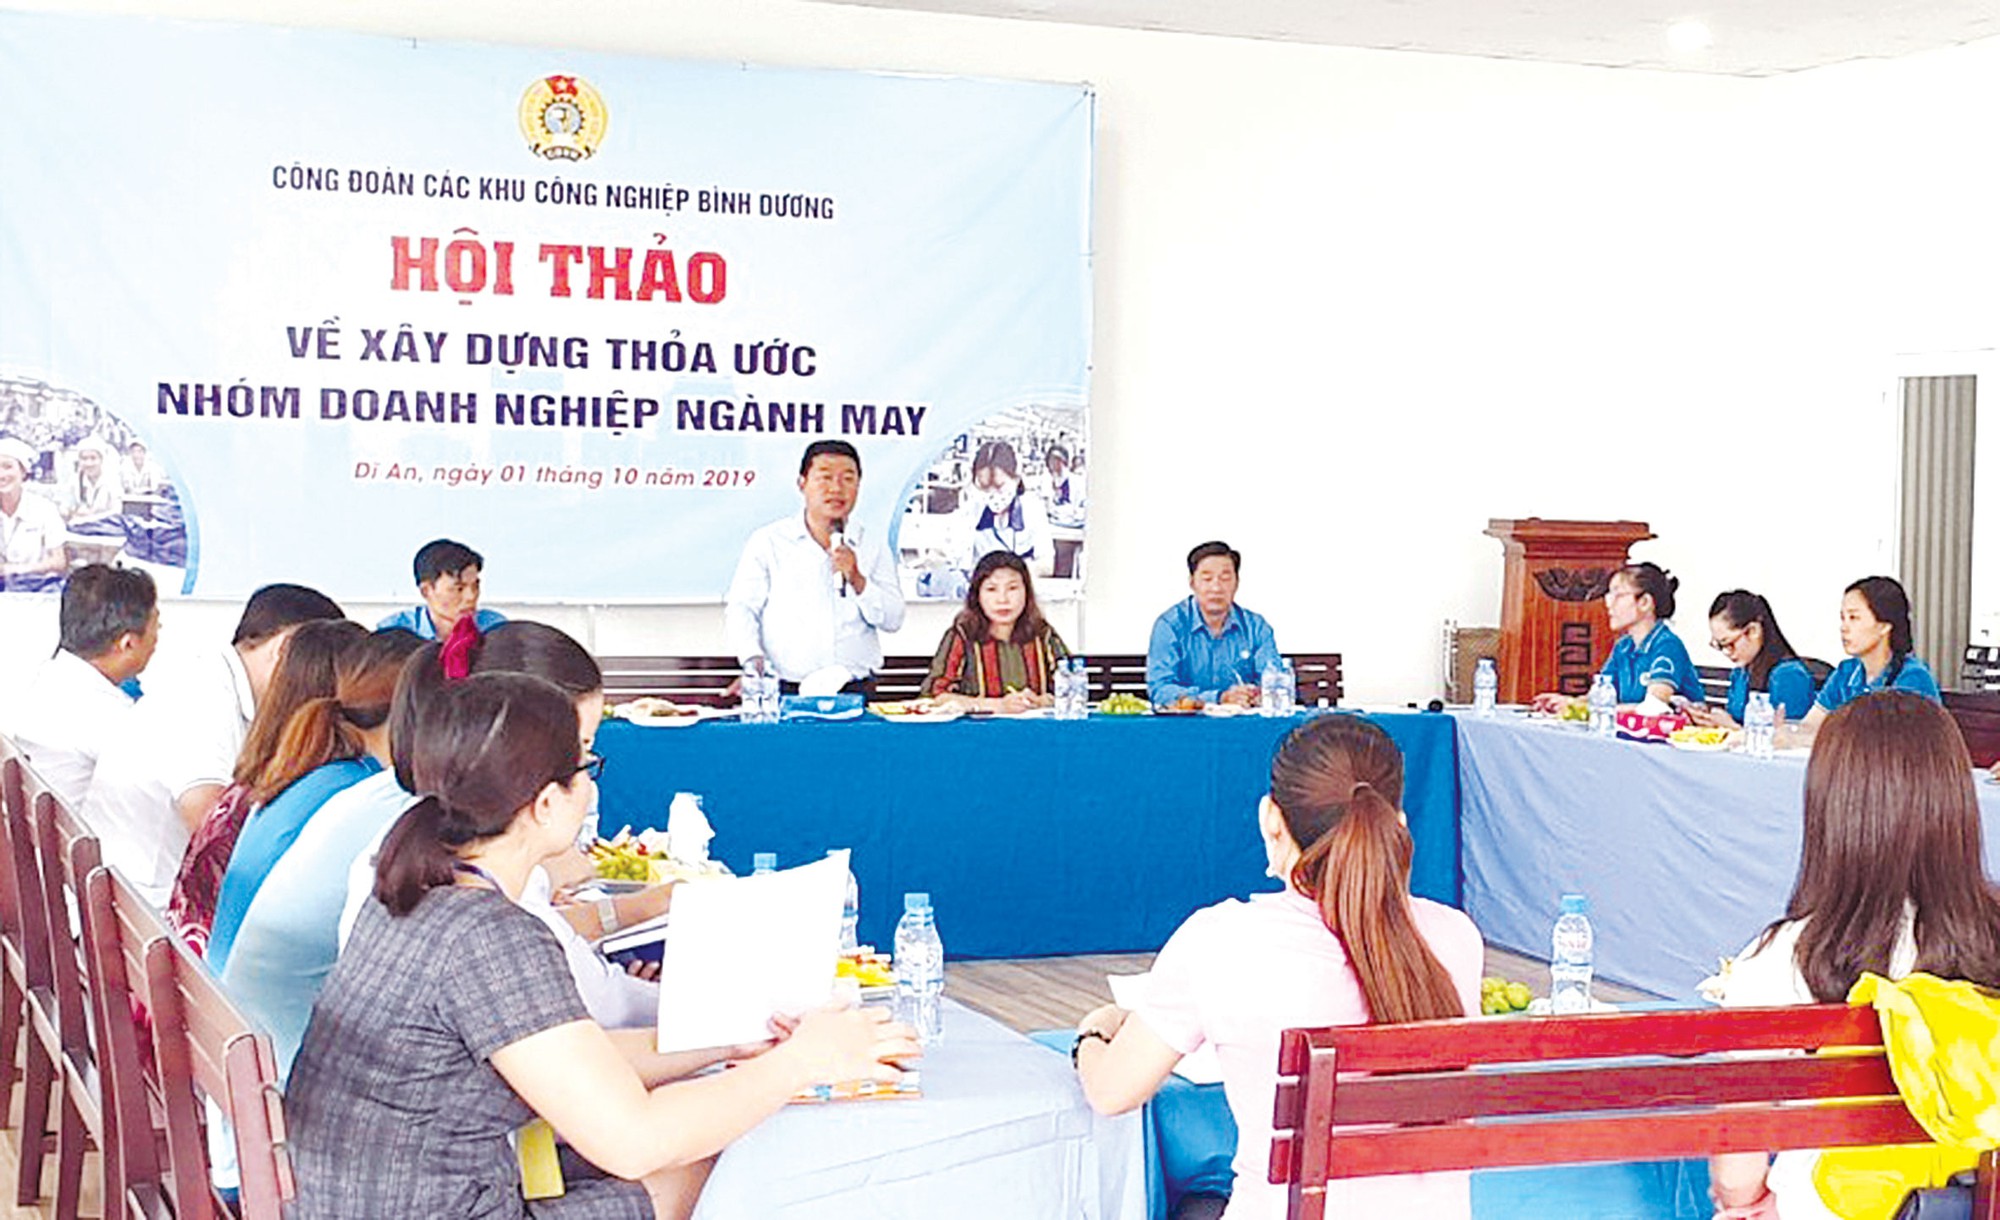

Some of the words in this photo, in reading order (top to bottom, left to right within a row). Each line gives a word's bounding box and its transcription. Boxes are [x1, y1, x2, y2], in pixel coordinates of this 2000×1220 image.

[272, 161, 339, 191] CÔNG
[348, 166, 414, 196] ĐOÀN
[423, 169, 470, 200] CÁC
[479, 177, 526, 203] KHU
[534, 175, 598, 207] CÔNG
[605, 182, 690, 217] NGHIỆP
[698, 185, 751, 215] BÌNH
[759, 193, 834, 220] DƯƠNG
[391, 226, 515, 306] HỘI
[538, 232, 727, 305] THẢO
[286, 315, 341, 360] VỀ
[359, 323, 448, 364] XÂY
[466, 331, 589, 375] DỰNG
[605, 328, 718, 374] THỎA
[733, 337, 817, 377] ƯỚC
[157, 377, 301, 419] NHÓM
[320, 387, 477, 425] DOANH
[495, 389, 660, 436] NGHIỆP
[676, 393, 825, 434] NGÀNH
[841, 403, 927, 436] MAY
[354, 462, 380, 479] Dĩ
[386, 463, 423, 483] An,
[433, 462, 493, 487] ngày
[500, 465, 525, 482] 01
[536, 464, 603, 489] tháng
[614, 467, 639, 485] 10
[645, 467, 695, 486] năm
[702, 469, 756, 487] 2019
